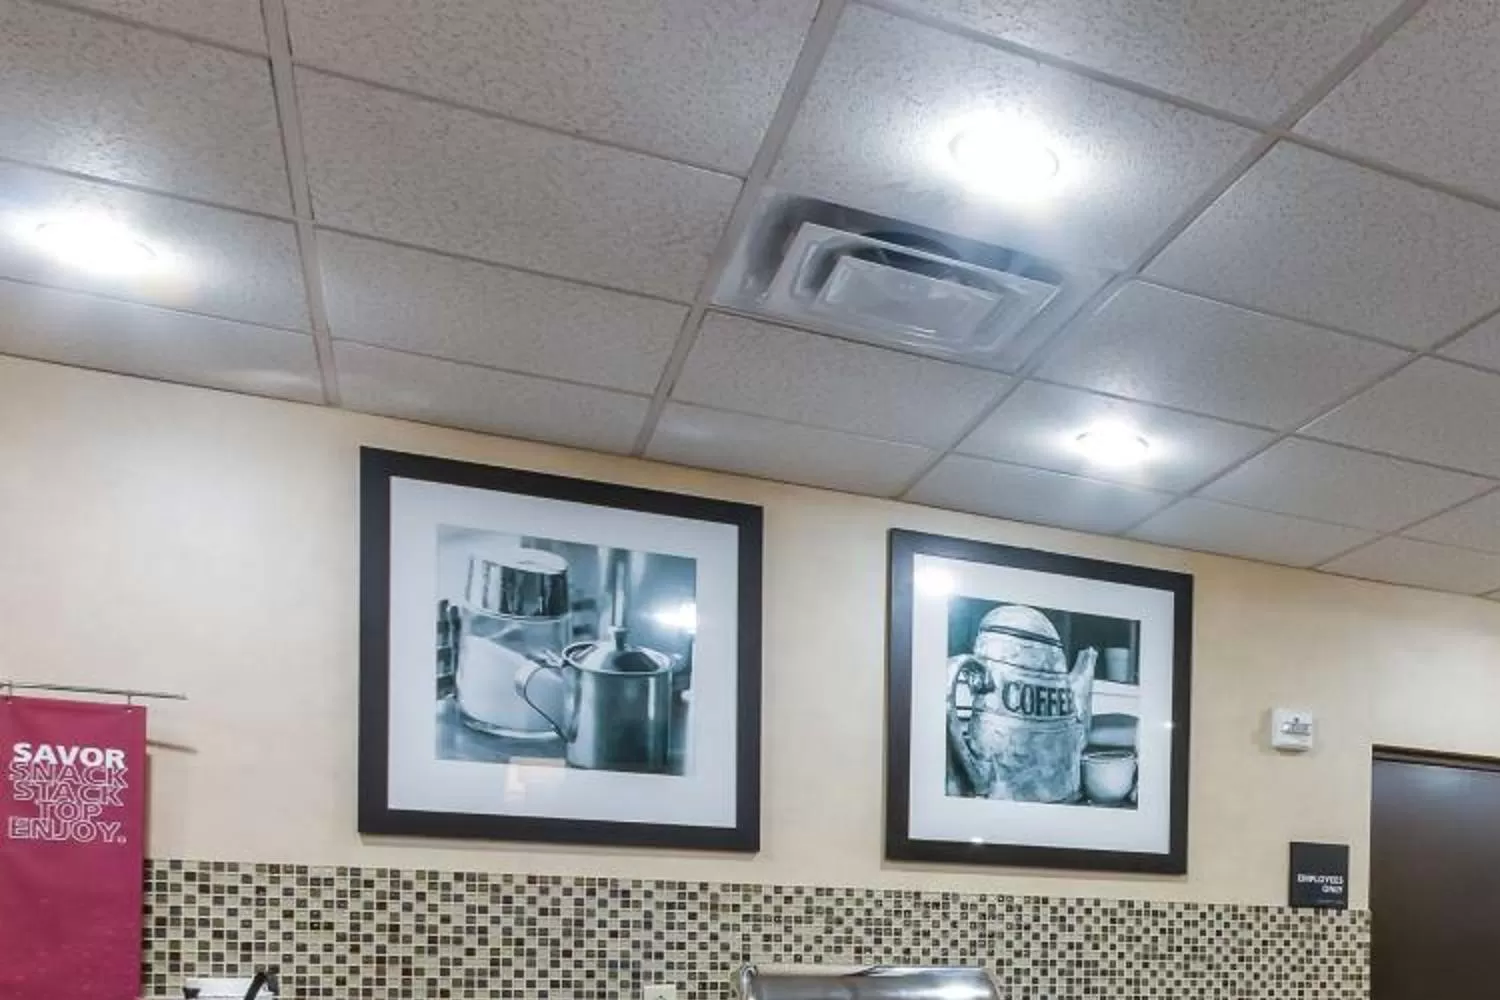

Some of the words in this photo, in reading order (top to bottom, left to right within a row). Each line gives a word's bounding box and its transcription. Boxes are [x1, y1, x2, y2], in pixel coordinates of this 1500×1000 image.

[1002, 679, 1074, 717] COFFEE
[13, 742, 126, 769] SAVOR
[8, 761, 129, 789] SNACK
[13, 779, 124, 807] STACK
[34, 799, 103, 822] TOP
